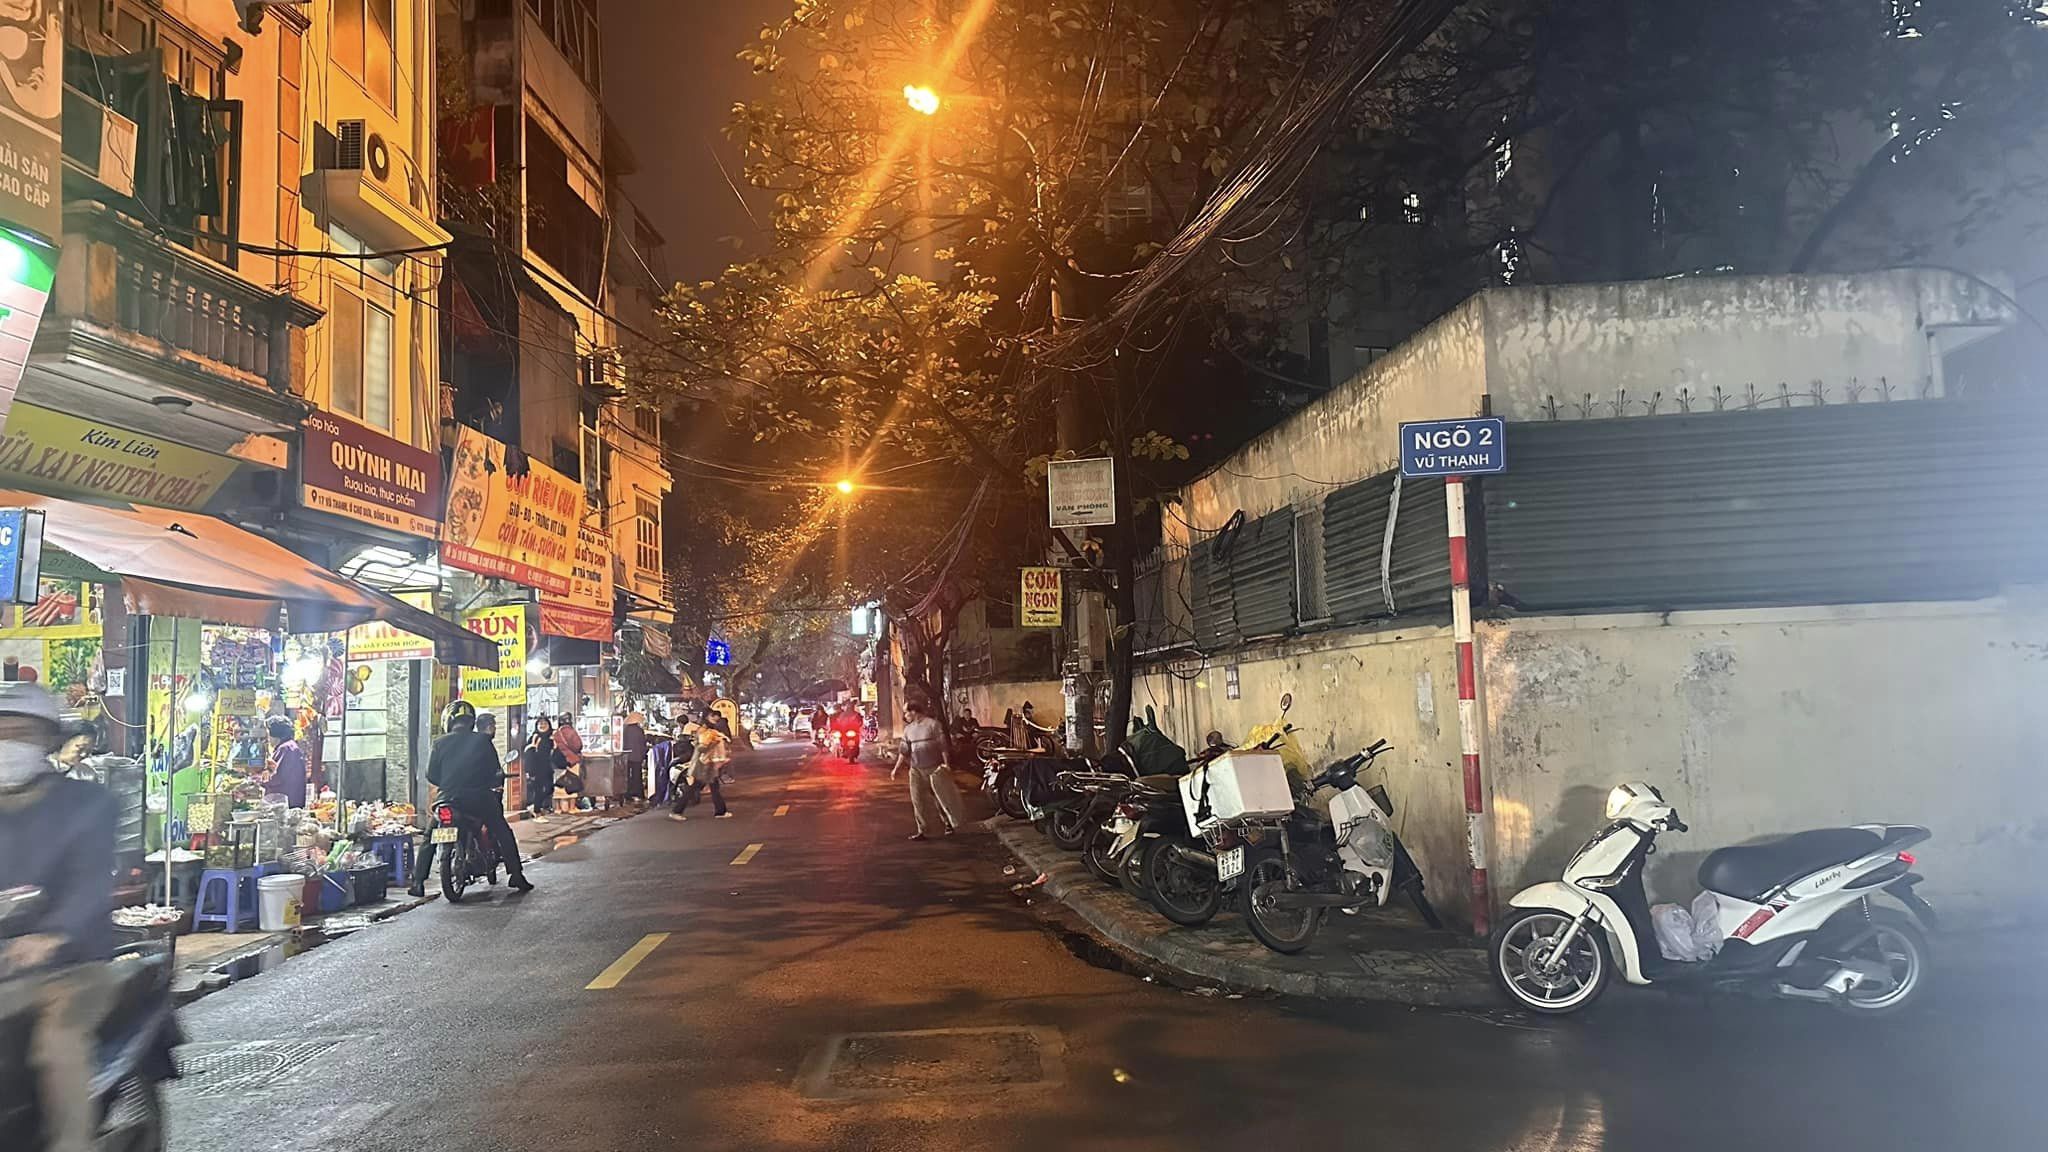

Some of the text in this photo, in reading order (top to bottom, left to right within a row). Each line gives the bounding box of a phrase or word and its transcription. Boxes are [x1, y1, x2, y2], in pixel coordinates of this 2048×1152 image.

[21, 155, 49, 185] SẢN
[0, 172, 50, 208] AO CẤP
[80, 428, 160, 460] Kim Liên
[1415, 425, 1493, 450] NGÕ 2
[26, 446, 88, 482] XAY
[331, 441, 426, 494] QUỲNH MAI
[1415, 453, 1489, 469] VŨ THẠNH
[344, 475, 363, 494] Rượu
[1025, 568, 1059, 590] CƠM
[1025, 592, 1058, 608] NGON
[467, 611, 519, 636] BÚN
